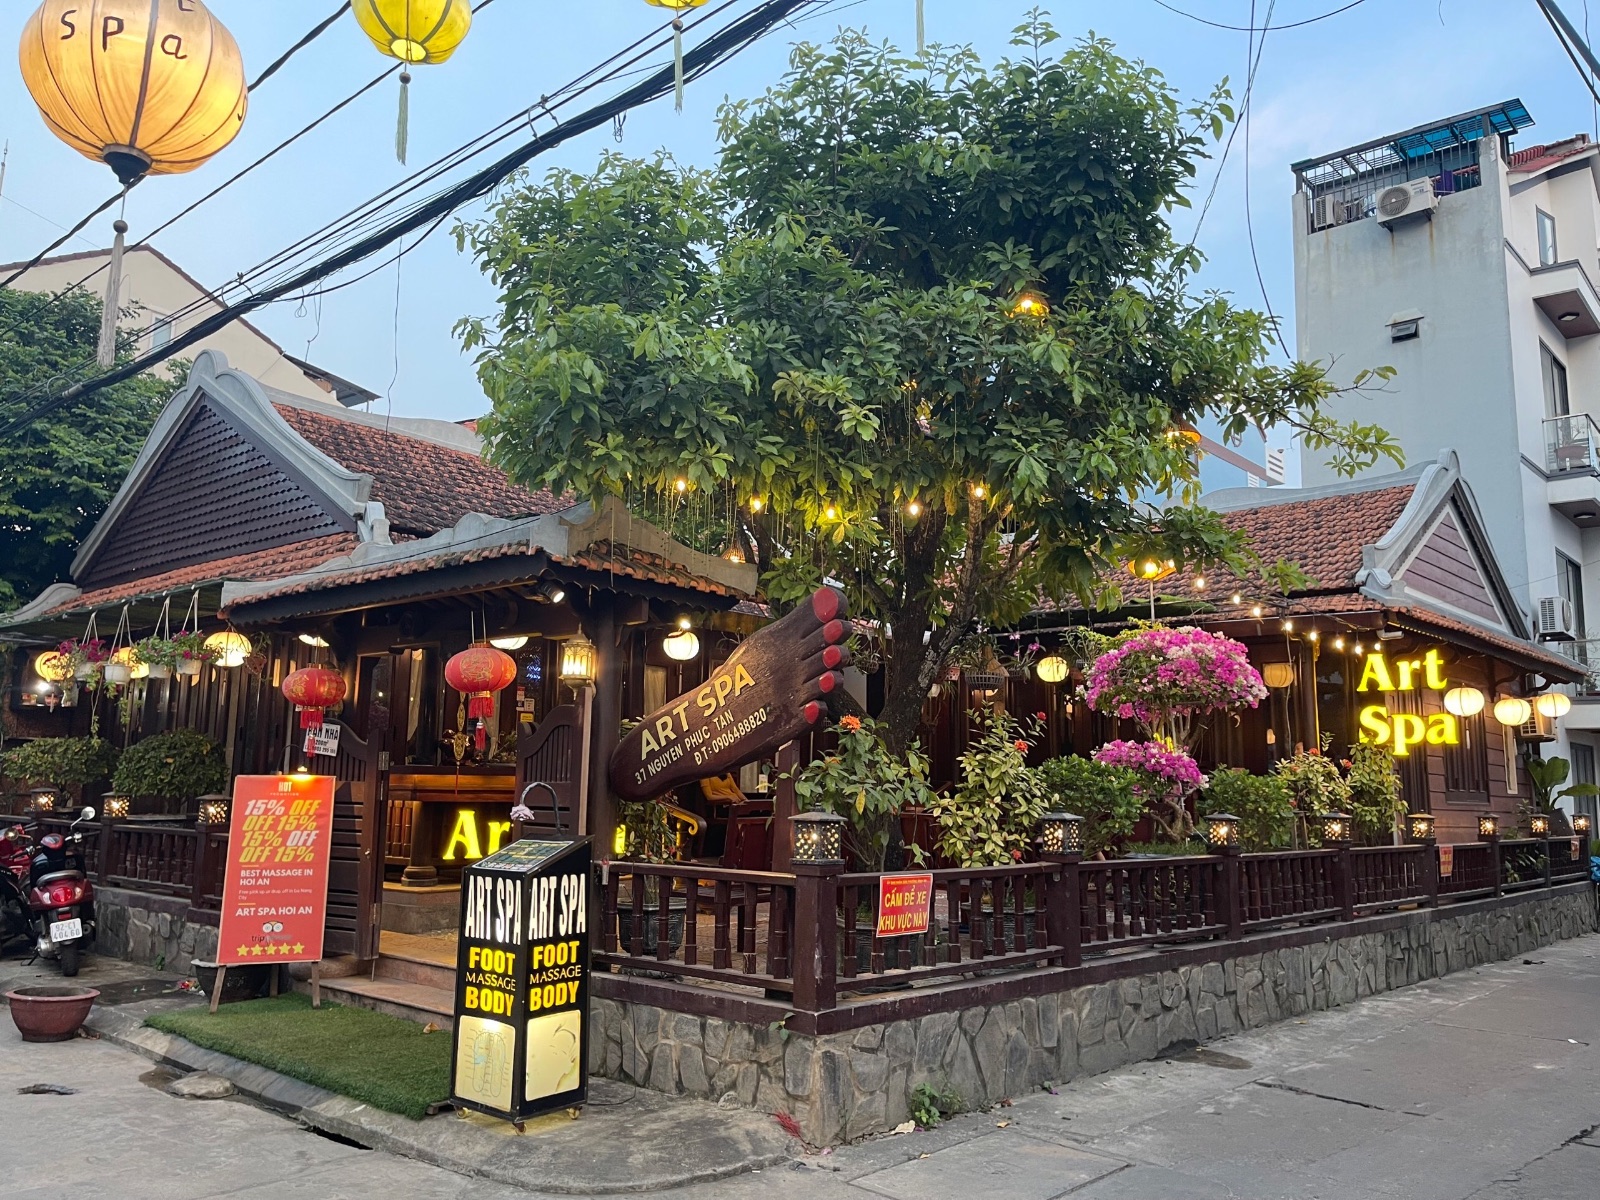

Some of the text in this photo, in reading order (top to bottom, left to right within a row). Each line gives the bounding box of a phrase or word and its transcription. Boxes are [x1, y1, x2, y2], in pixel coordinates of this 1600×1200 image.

[1356, 649, 1448, 692] Art
[641, 663, 756, 761] ART SPA
[1358, 705, 1460, 756] Spa
[634, 709, 735, 785] 37 NGUYEN PHUC TAN
[278, 781, 293, 792] HOT
[244, 800, 322, 816] 15% OFF
[242, 815, 318, 831] OFF 15%
[241, 830, 320, 847] 15% OFF
[238, 846, 315, 863] OFF 15%
[240, 869, 261, 878] BEST
[262, 869, 303, 877] MASSAGE
[240, 878, 270, 886] HOI AN
[528, 873, 586, 940] ART SPA
[885, 888, 902, 907] CẤM
[916, 891, 927, 904] XE
[235, 906, 313, 917] ART SPA HOI AN
[465, 875, 521, 945] ART SPA
[879, 915, 896, 930] KHU
[469, 946, 516, 976] FOOT
[533, 940, 580, 970] FOOT
[465, 972, 516, 992] MASSAGE
[529, 964, 582, 985] MASSAGE
[465, 985, 514, 1017] BODY
[529, 980, 580, 1012] BODY
